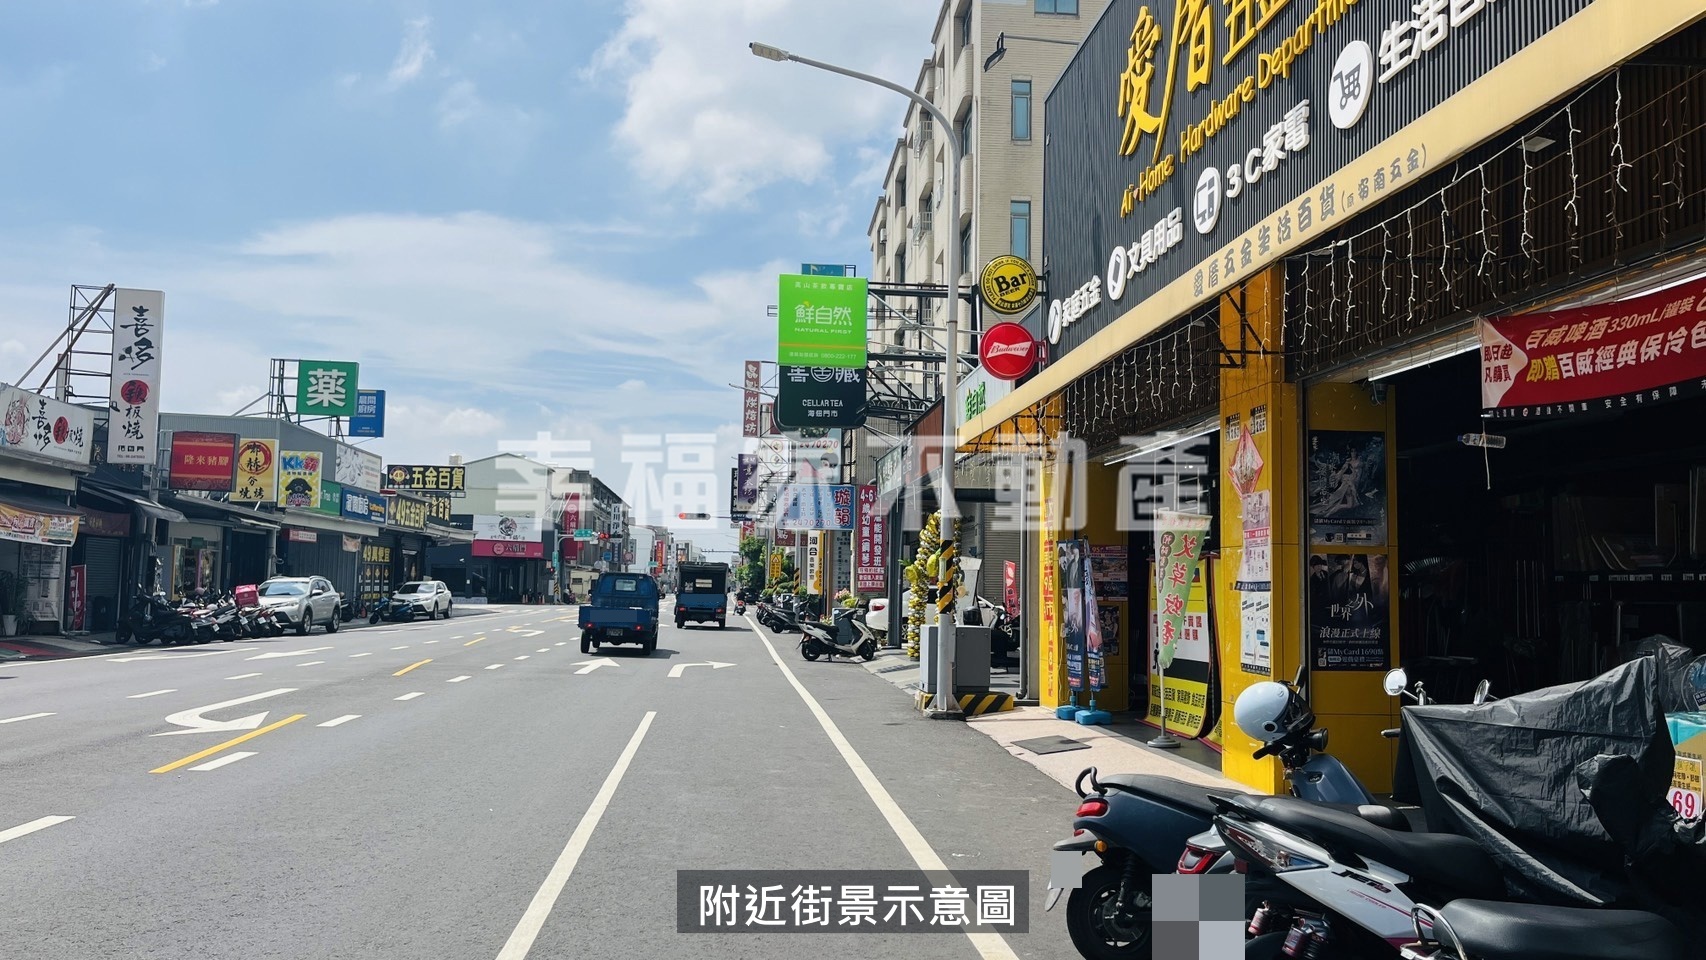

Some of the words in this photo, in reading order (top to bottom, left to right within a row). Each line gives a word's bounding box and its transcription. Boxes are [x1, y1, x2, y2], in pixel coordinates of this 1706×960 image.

[1140, 153, 1175, 202] Home
[1181, 75, 1256, 163] Hardware
[1127, 207, 1183, 279] 文具用品
[994, 273, 1027, 292] Bar
[794, 304, 852, 326] 鮮自然
[991, 344, 1029, 354] Budweiser
[1484, 344, 1513, 362] 即日起
[1484, 363, 1512, 383] 凡購買
[802, 399, 830, 407] CELLAR
[831, 399, 844, 407] TEA
[1604, 386, 1678, 409] 安全有保障
[411, 466, 464, 490] 五金百貨
[1319, 626, 1381, 639] 浪漫正式上線
[1673, 791, 1695, 818] 69
